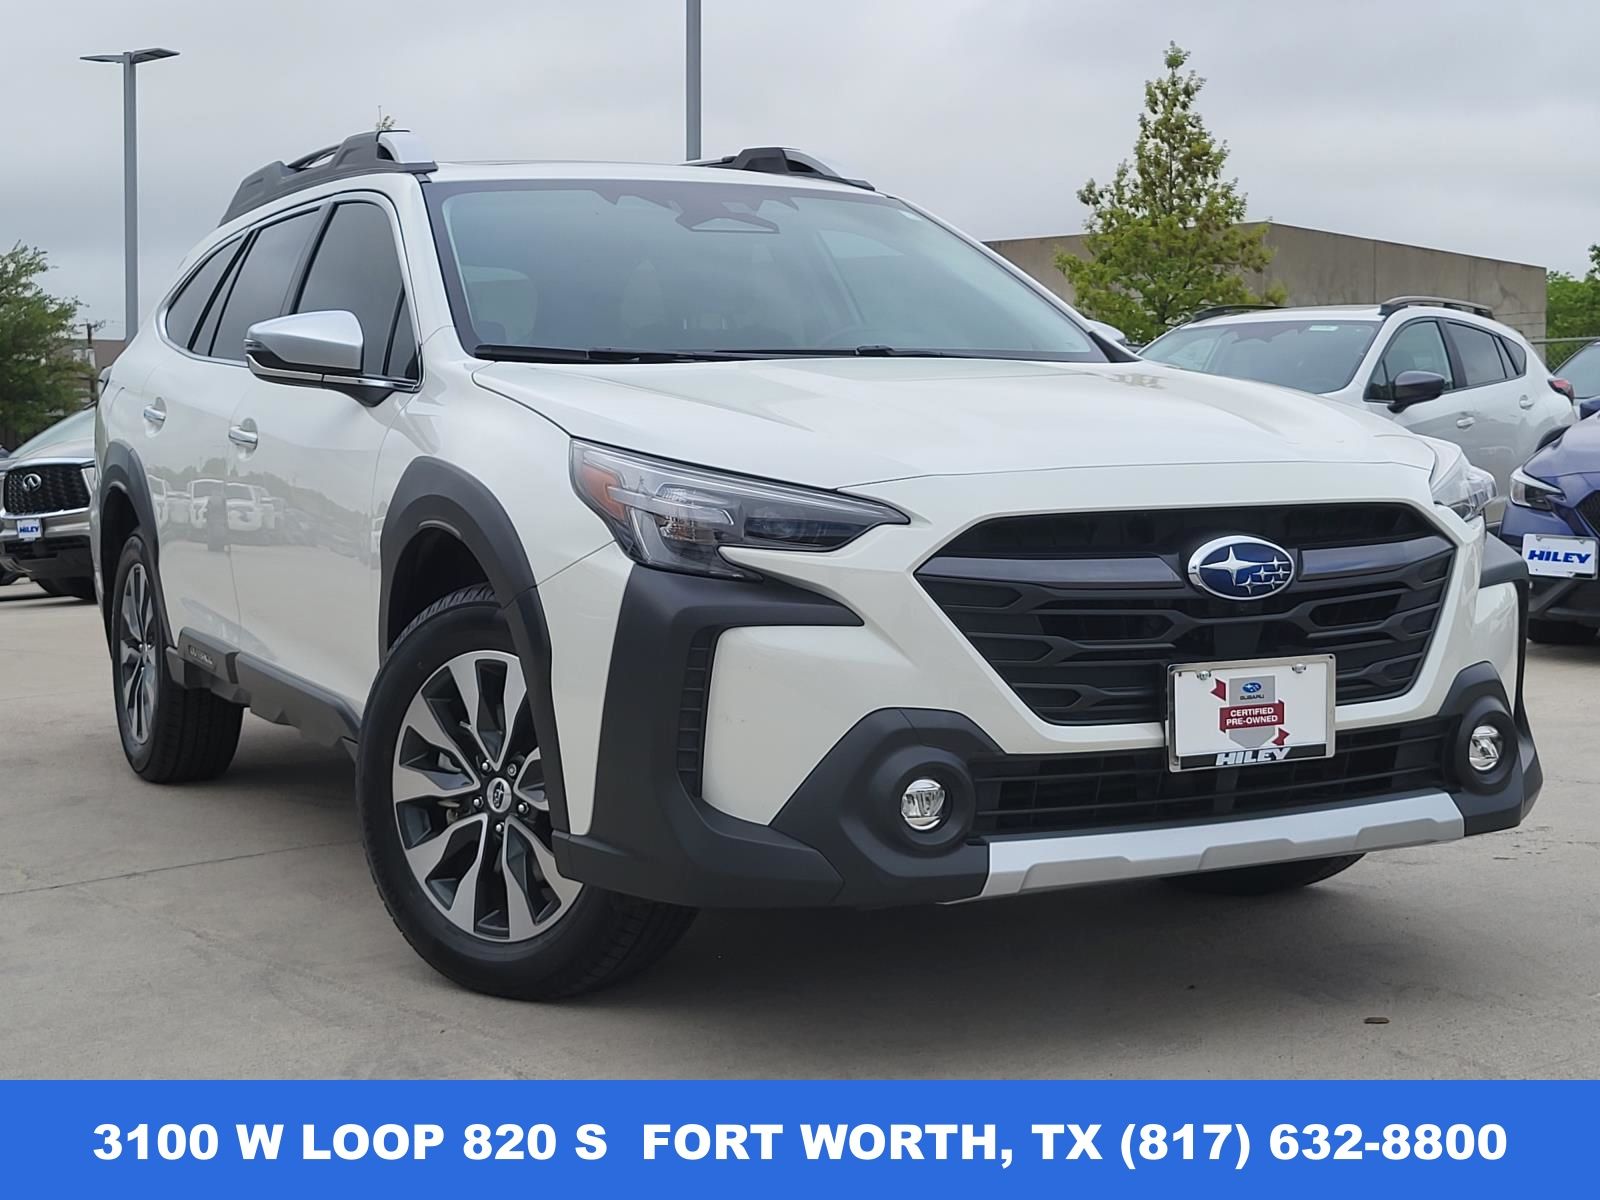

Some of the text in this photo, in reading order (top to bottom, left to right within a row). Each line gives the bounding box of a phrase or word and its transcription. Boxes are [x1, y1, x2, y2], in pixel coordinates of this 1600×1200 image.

[1528, 550, 1591, 564] HILEY
[1230, 707, 1274, 717] CERTIFIED
[1226, 715, 1278, 726] PRE-OWNED
[1215, 747, 1291, 766] HILEY
